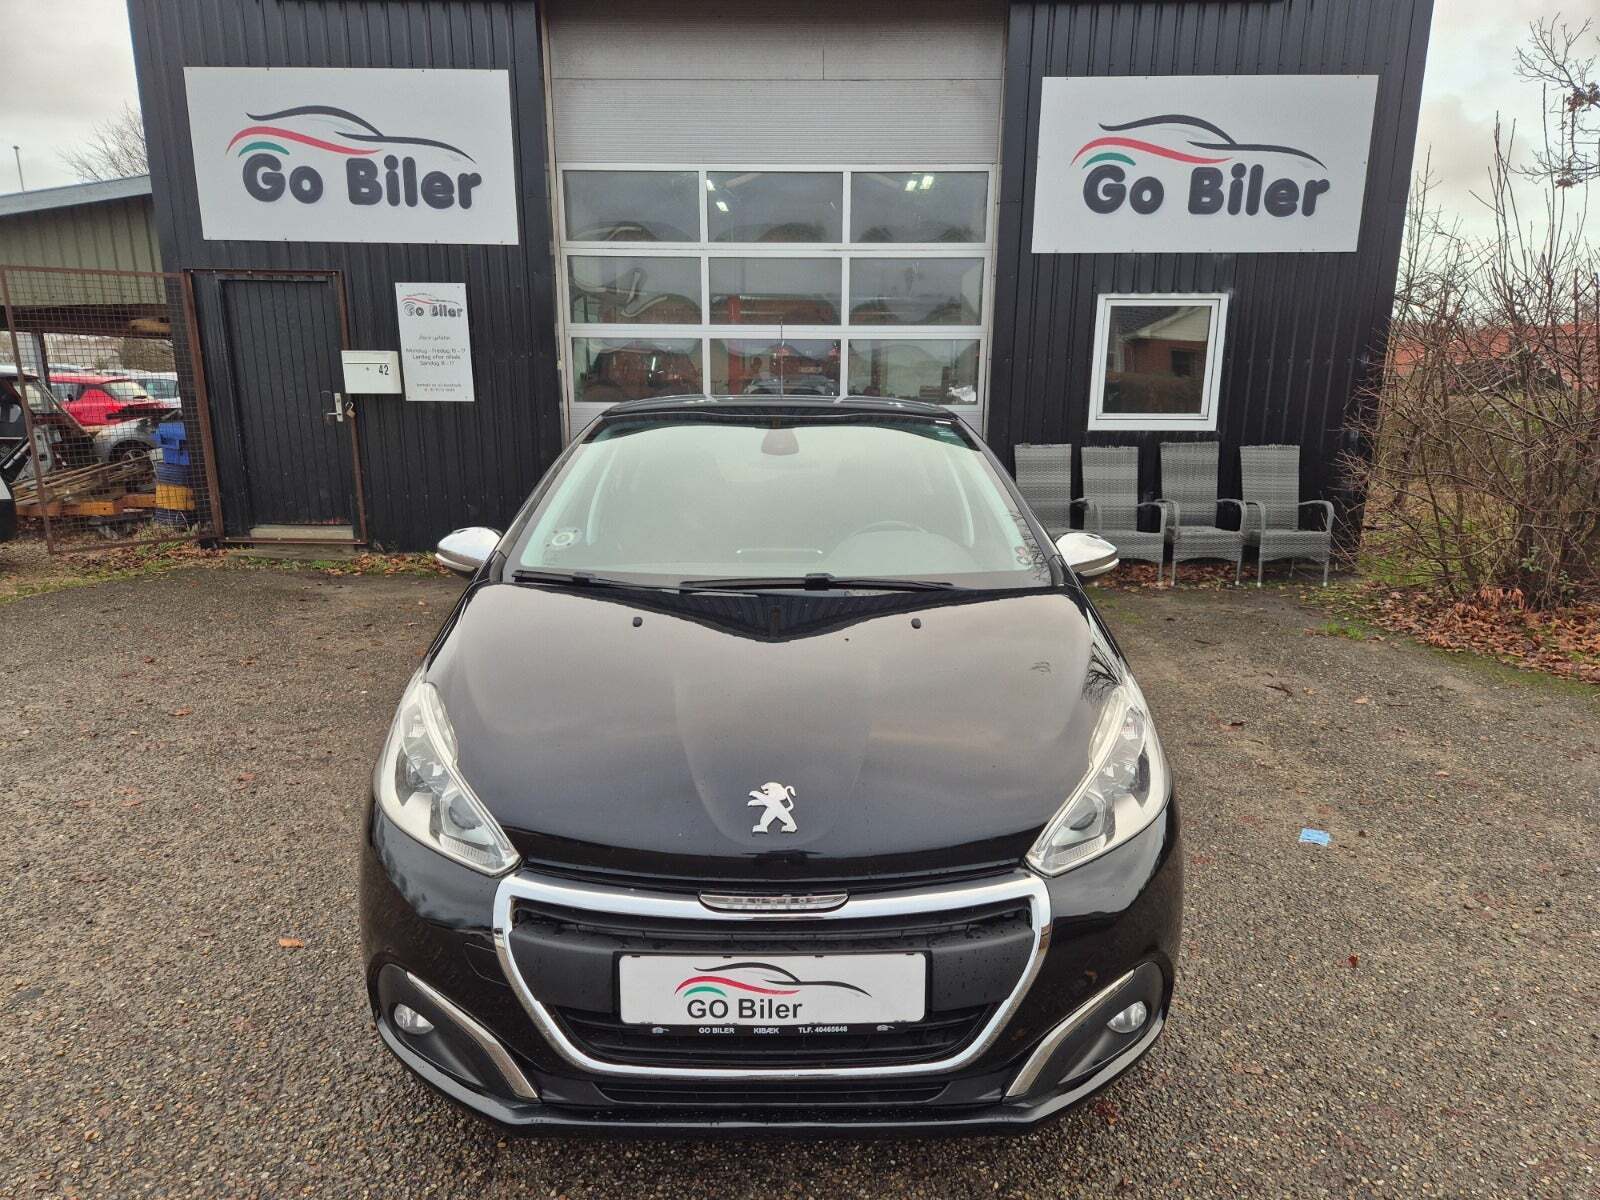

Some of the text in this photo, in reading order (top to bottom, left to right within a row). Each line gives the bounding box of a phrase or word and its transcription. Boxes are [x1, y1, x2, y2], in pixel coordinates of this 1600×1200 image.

[243, 153, 482, 209] Go Biler
[1083, 162, 1330, 217] Go Biler
[403, 303, 425, 317] Go
[378, 364, 389, 376] 42
[687, 998, 802, 1019] GO Biler
